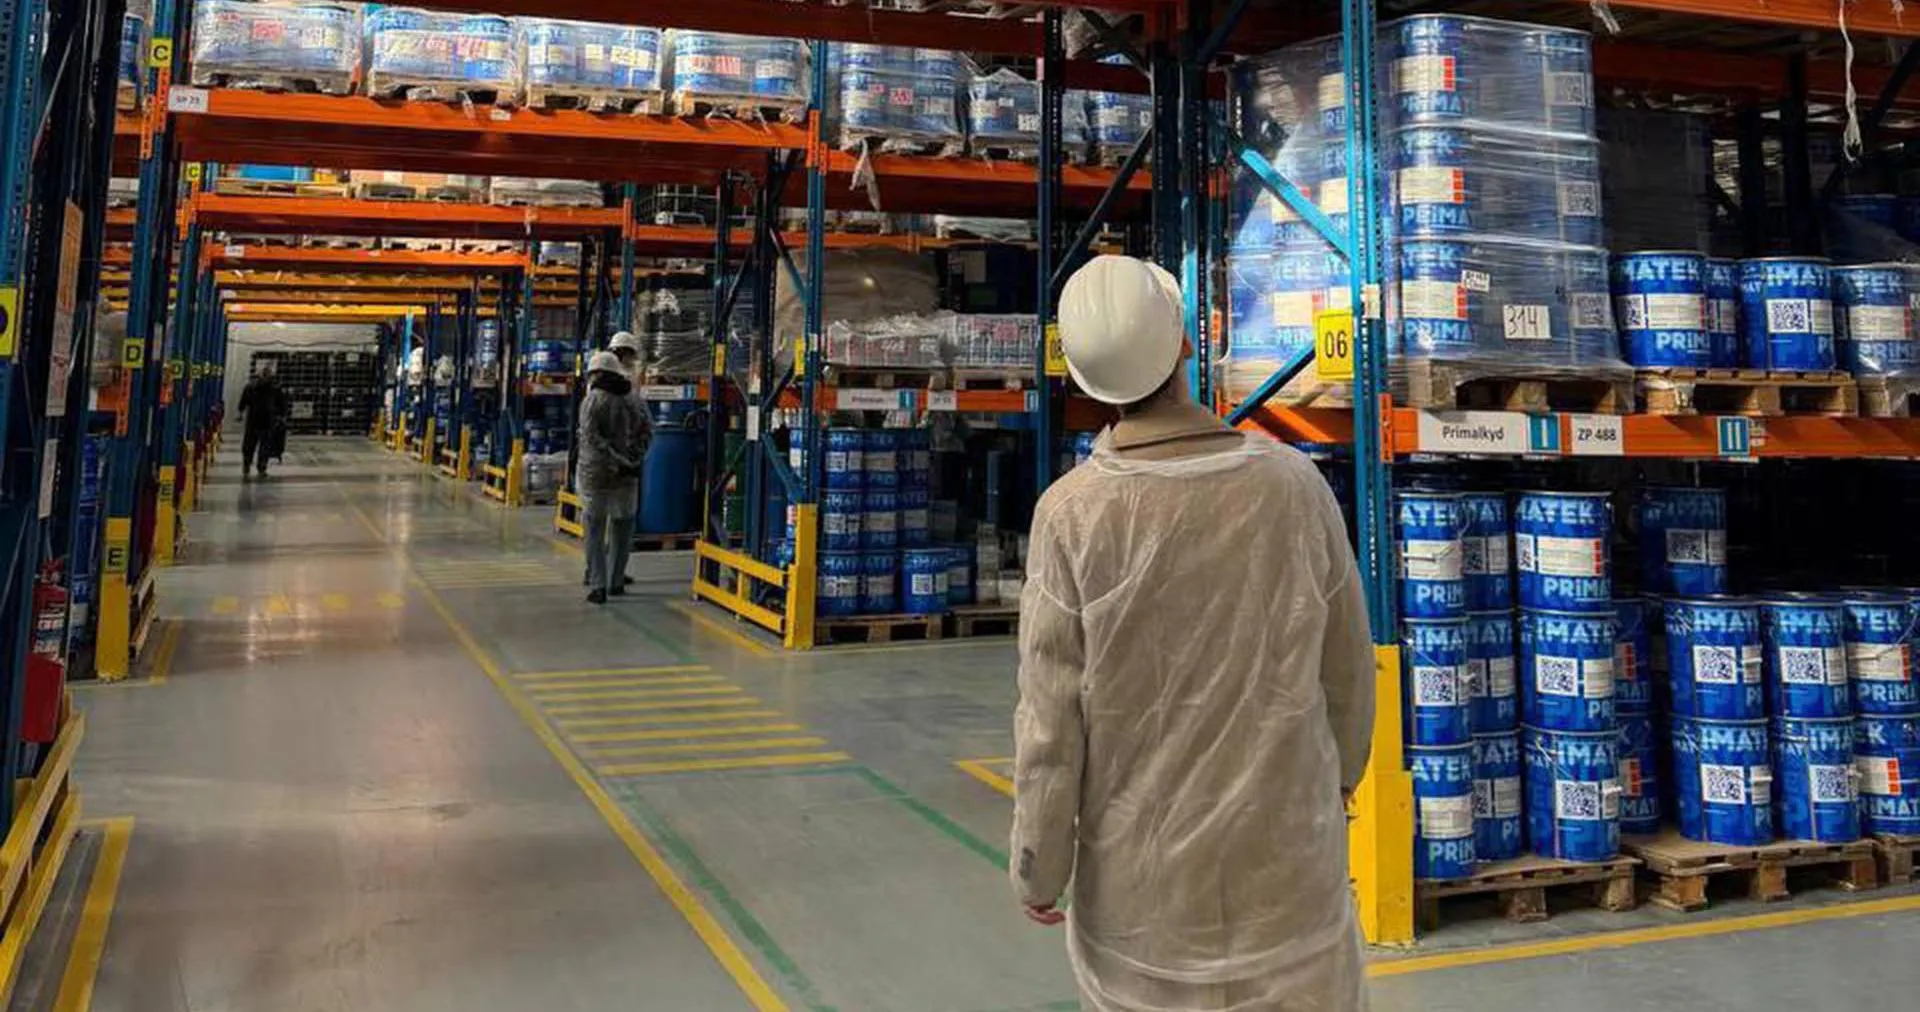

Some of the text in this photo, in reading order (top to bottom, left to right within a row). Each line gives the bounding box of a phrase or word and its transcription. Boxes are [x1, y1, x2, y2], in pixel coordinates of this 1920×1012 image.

[154, 44, 168, 61] C
[1505, 305, 1539, 337] 314
[1325, 330, 1347, 358] 06
[126, 345, 140, 361] D
[1442, 425, 1505, 442] Primalkyd
[1577, 429, 1595, 442] ZP
[162, 484, 171, 496] E
[108, 548, 123, 566] E
